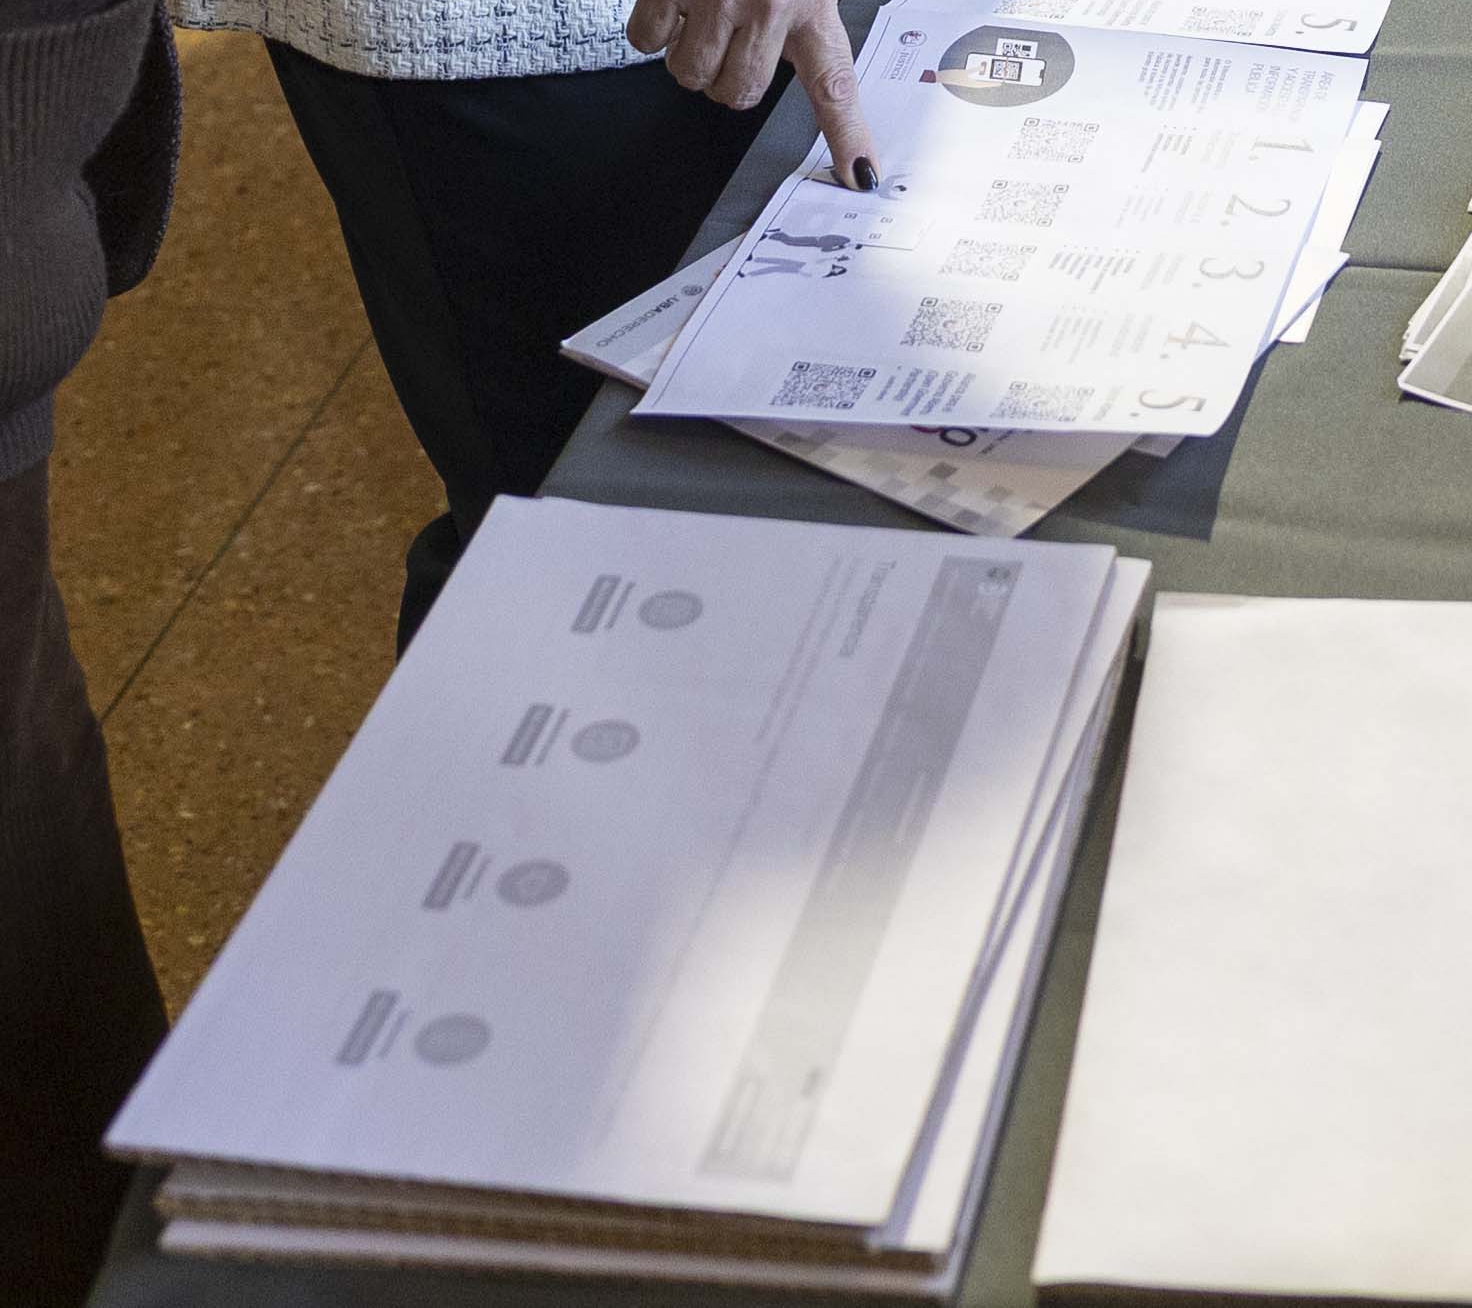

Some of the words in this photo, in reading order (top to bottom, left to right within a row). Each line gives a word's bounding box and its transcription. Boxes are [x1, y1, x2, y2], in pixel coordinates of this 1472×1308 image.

[1220, 194, 1290, 227] 2.
[1192, 258, 1264, 288] 3.
[1160, 322, 1231, 360] 4.
[1130, 389, 1207, 418] 5.
